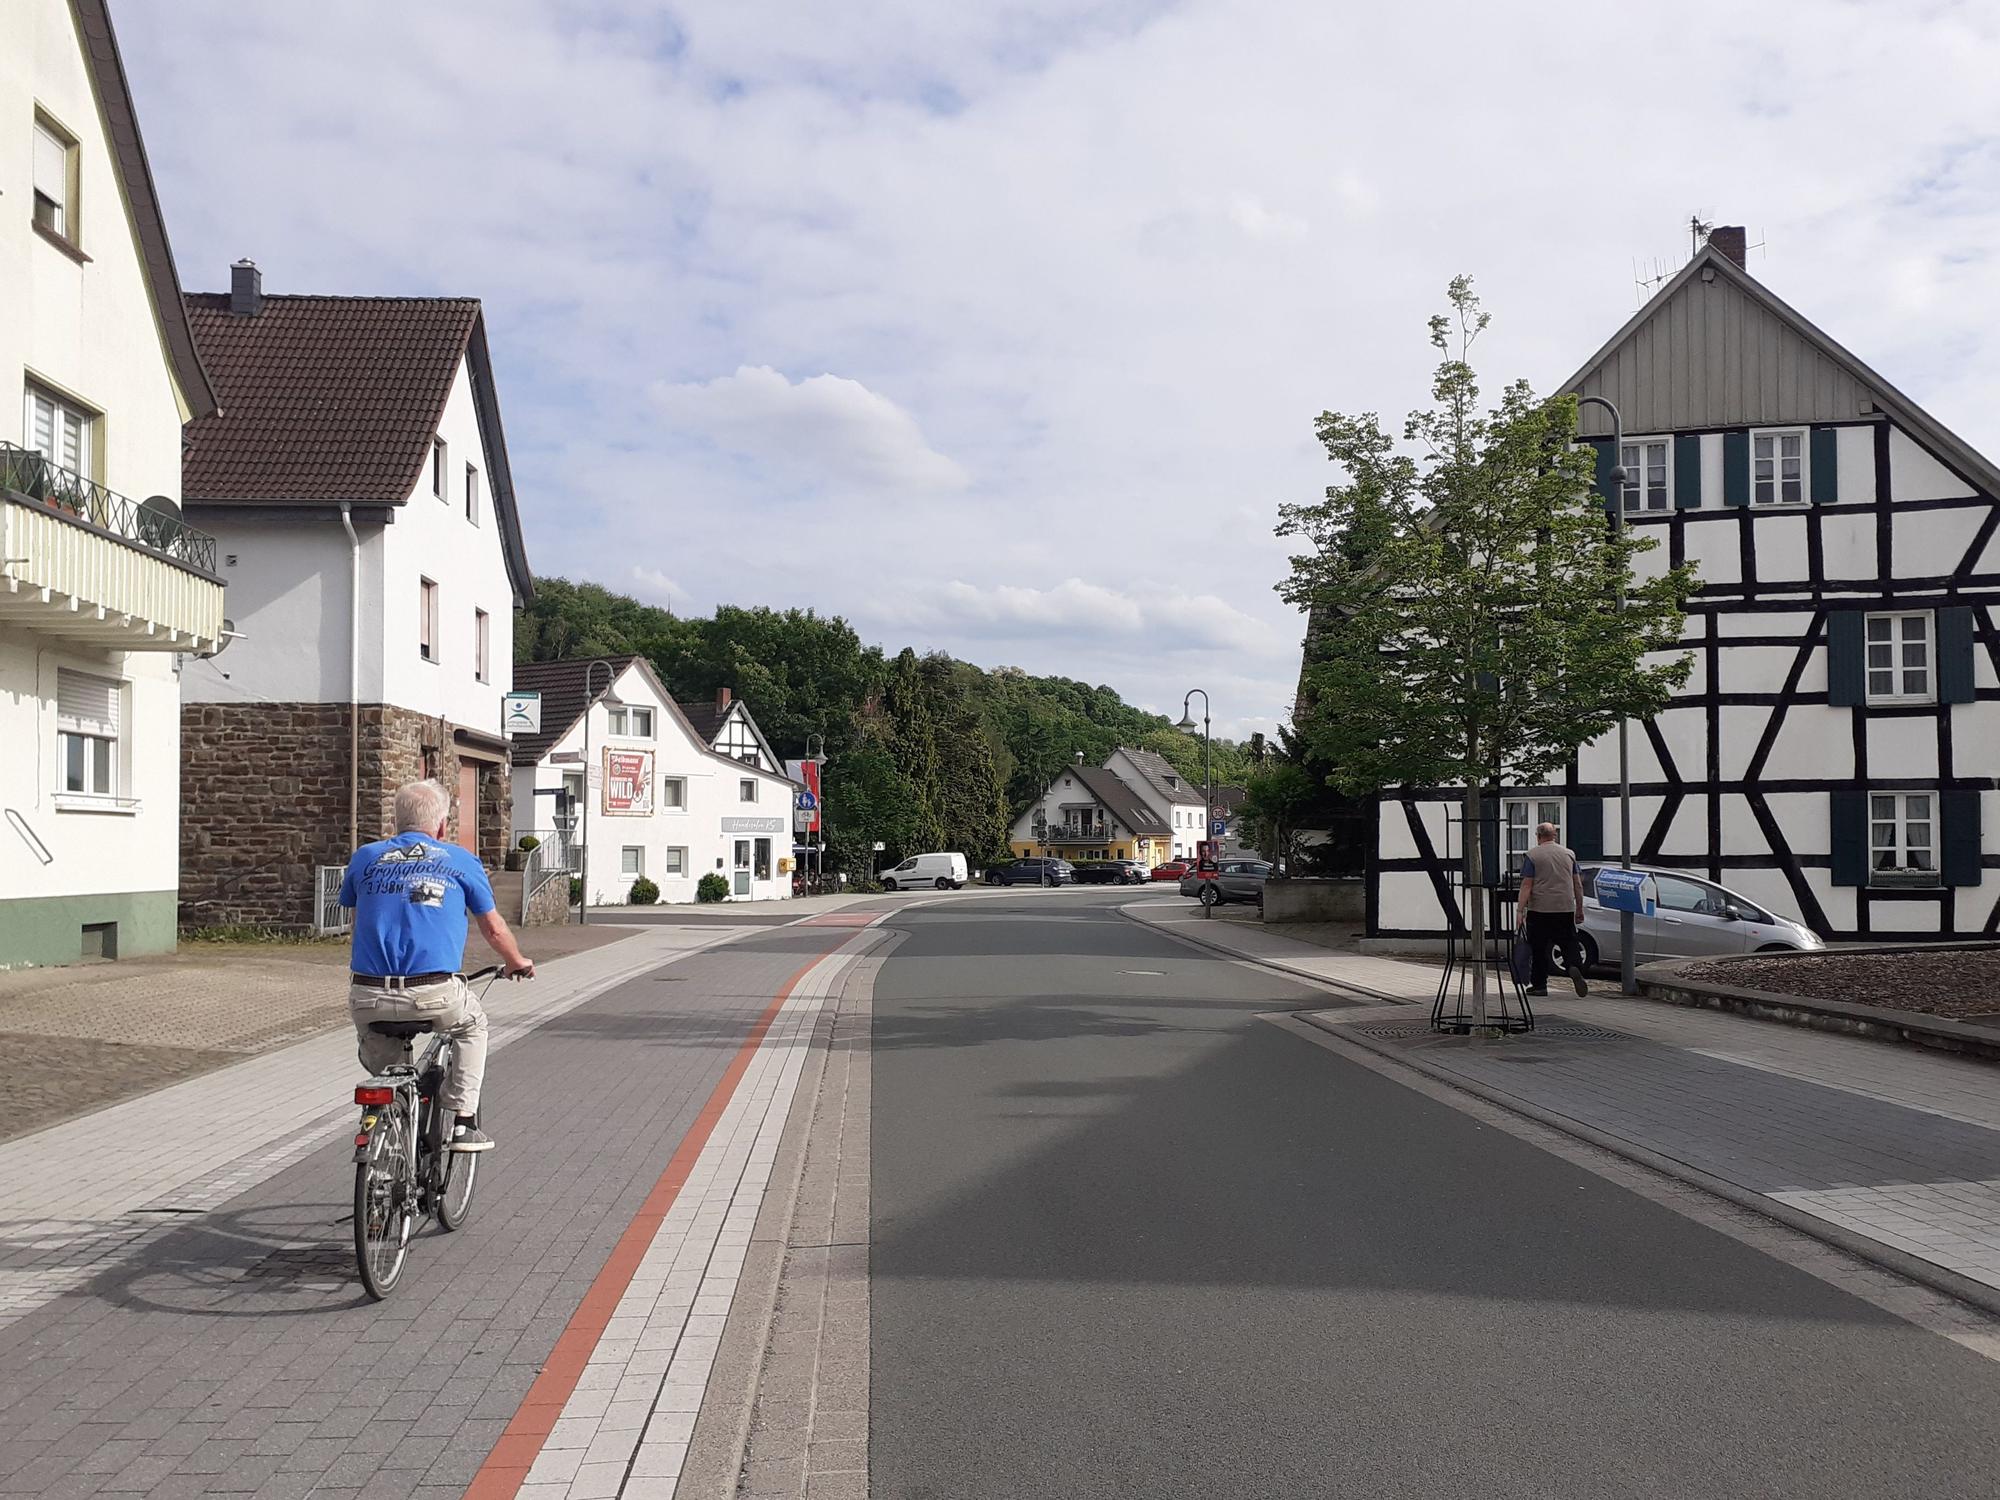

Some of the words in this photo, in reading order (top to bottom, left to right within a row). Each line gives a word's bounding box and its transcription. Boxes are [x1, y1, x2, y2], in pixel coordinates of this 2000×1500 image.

[610, 781, 633, 799] WILD
[1214, 822, 1222, 834] P
[1600, 870, 1642, 884] Einwanderung
